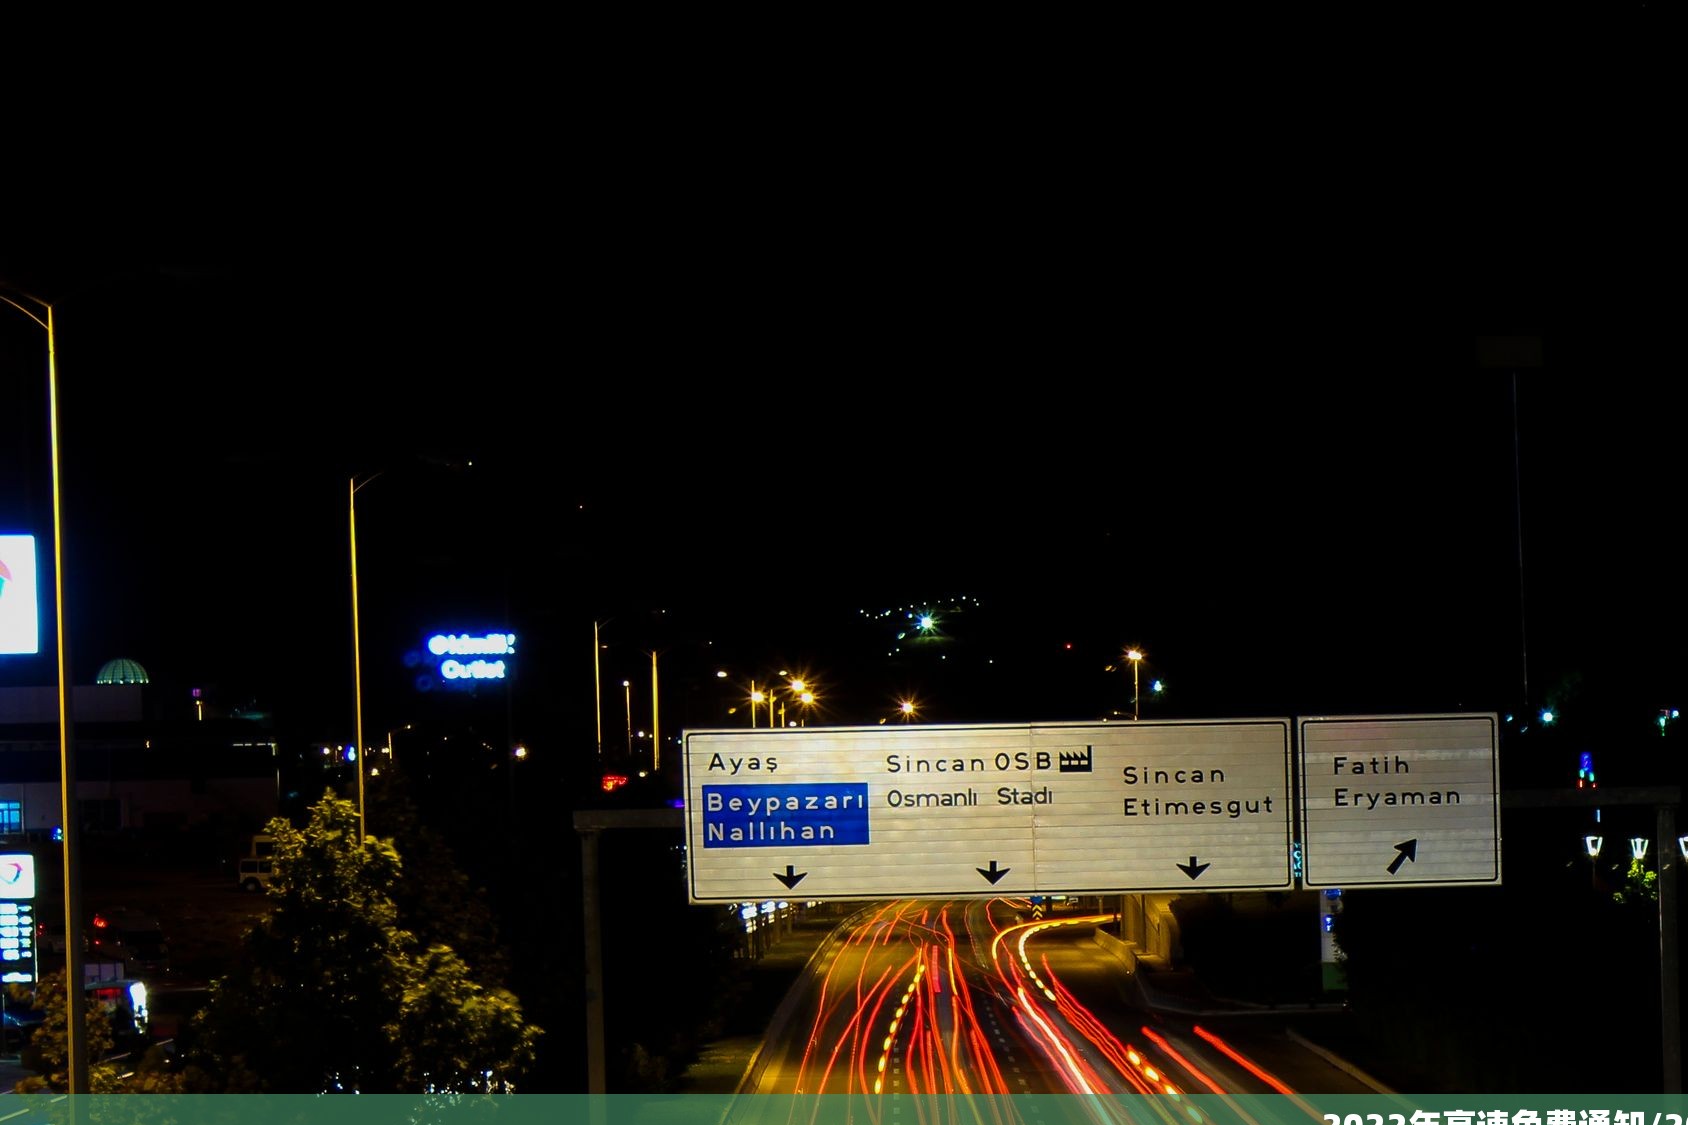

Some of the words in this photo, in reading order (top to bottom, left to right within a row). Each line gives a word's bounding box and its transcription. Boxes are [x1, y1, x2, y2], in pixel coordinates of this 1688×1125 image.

[708, 752, 778, 775] Ayaş
[886, 754, 985, 773] Sincan
[995, 752, 1052, 771] OSB
[1333, 755, 1410, 775] Fatih
[1122, 766, 1225, 785] Sincan
[708, 792, 863, 816] Beypazarı
[887, 788, 978, 808] Osmanlı
[997, 786, 1053, 806] Stadı
[1123, 796, 1273, 819] Etimesgut
[1334, 788, 1461, 810] Eryaman
[708, 822, 835, 841] Nallıhan
